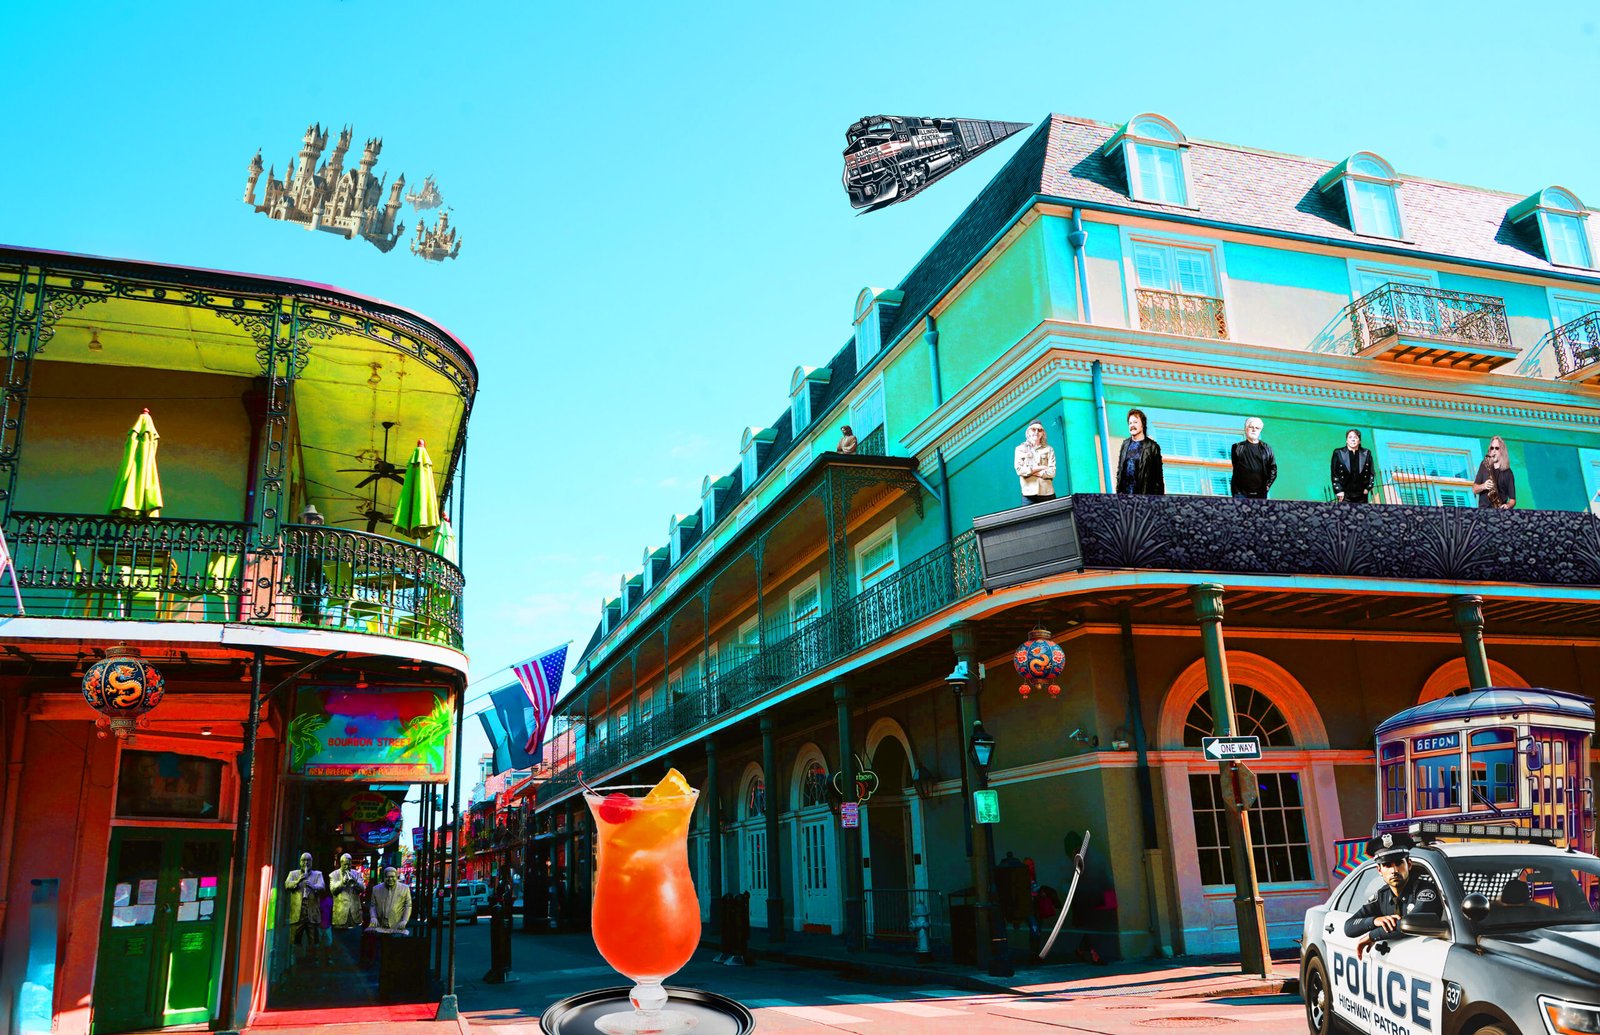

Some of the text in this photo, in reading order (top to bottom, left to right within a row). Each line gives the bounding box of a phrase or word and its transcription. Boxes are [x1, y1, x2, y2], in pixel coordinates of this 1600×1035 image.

[854, 146, 878, 158] ILLINOIS
[328, 737, 412, 747] BOURBON STREET
[1221, 743, 1253, 753] ONE WAY
[308, 768, 323, 776] NEW
[1334, 951, 1432, 1032] POLICE
[1446, 987, 1460, 1005] 337
[1338, 993, 1371, 1023] HIGHWAY
